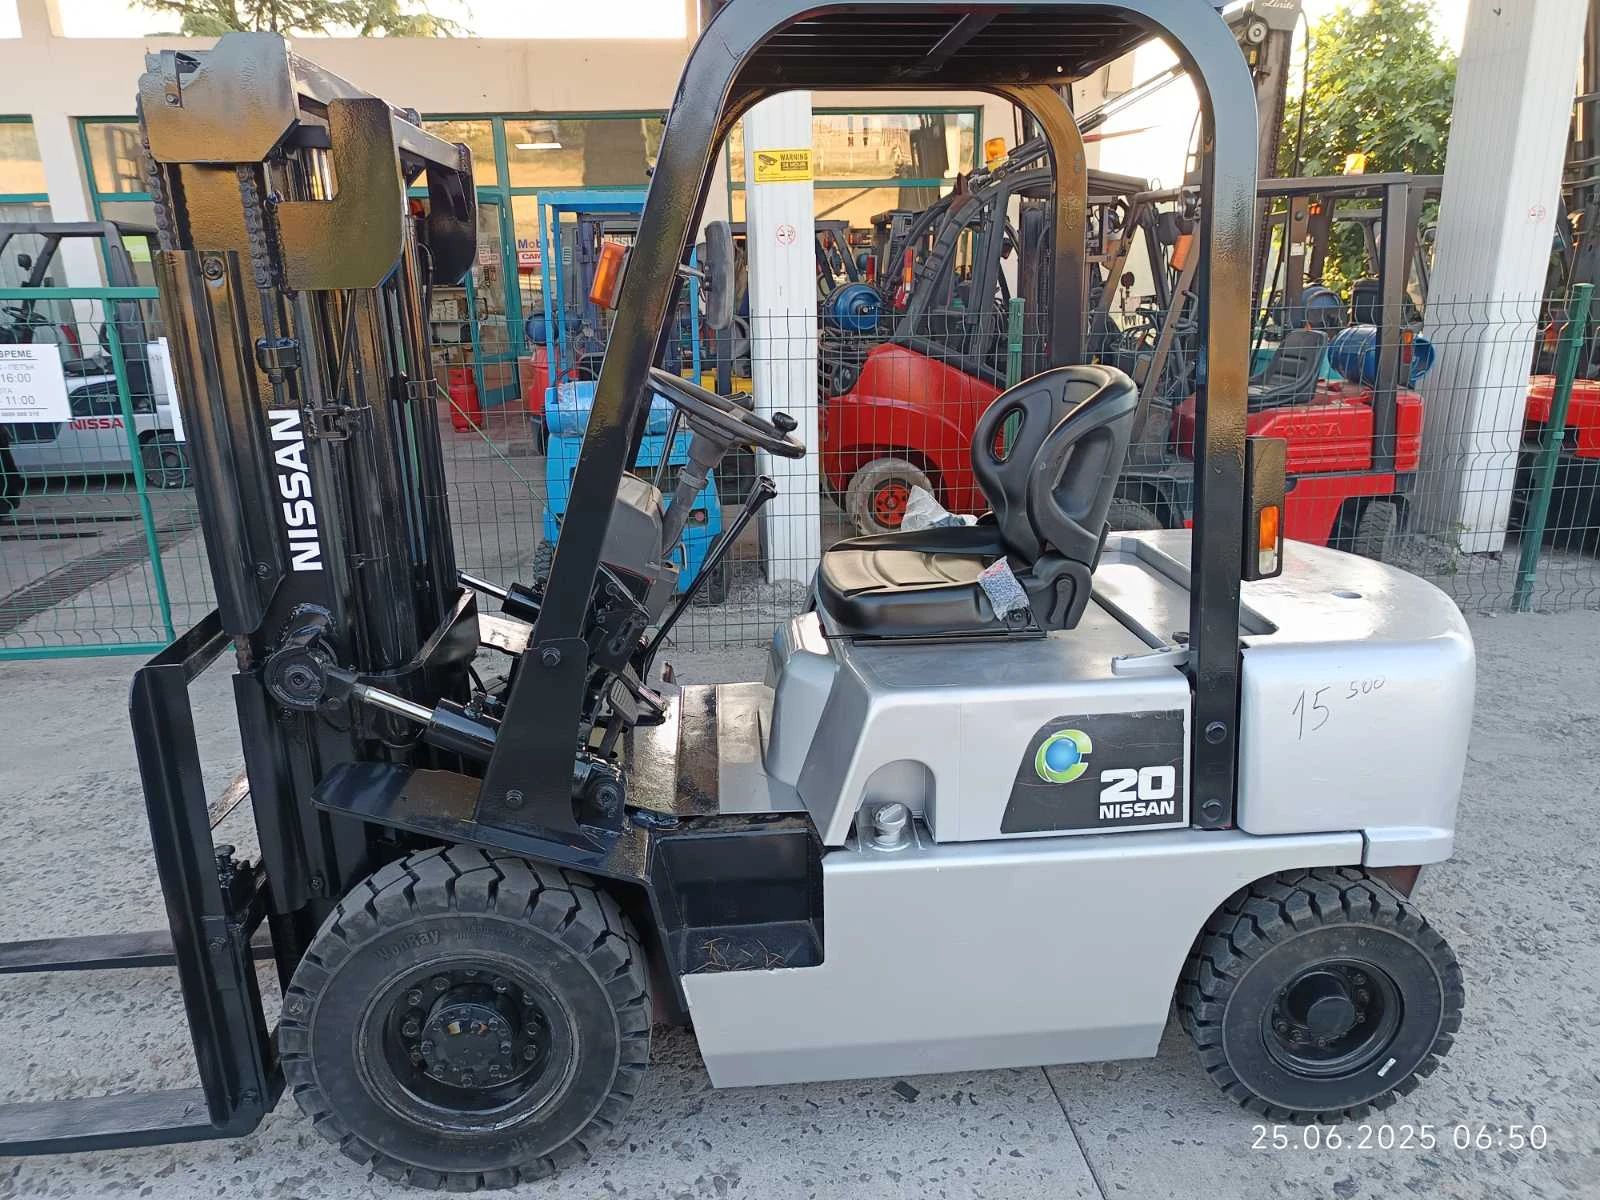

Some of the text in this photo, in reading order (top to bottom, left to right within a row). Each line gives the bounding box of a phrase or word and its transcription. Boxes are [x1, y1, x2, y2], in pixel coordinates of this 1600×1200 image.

[69, 417, 124, 430] NISSA
[268, 409, 323, 571] NISSAN
[1291, 676, 1385, 741] 15 500
[1100, 765, 1176, 803] 20
[1099, 801, 1175, 820] NISSAN
